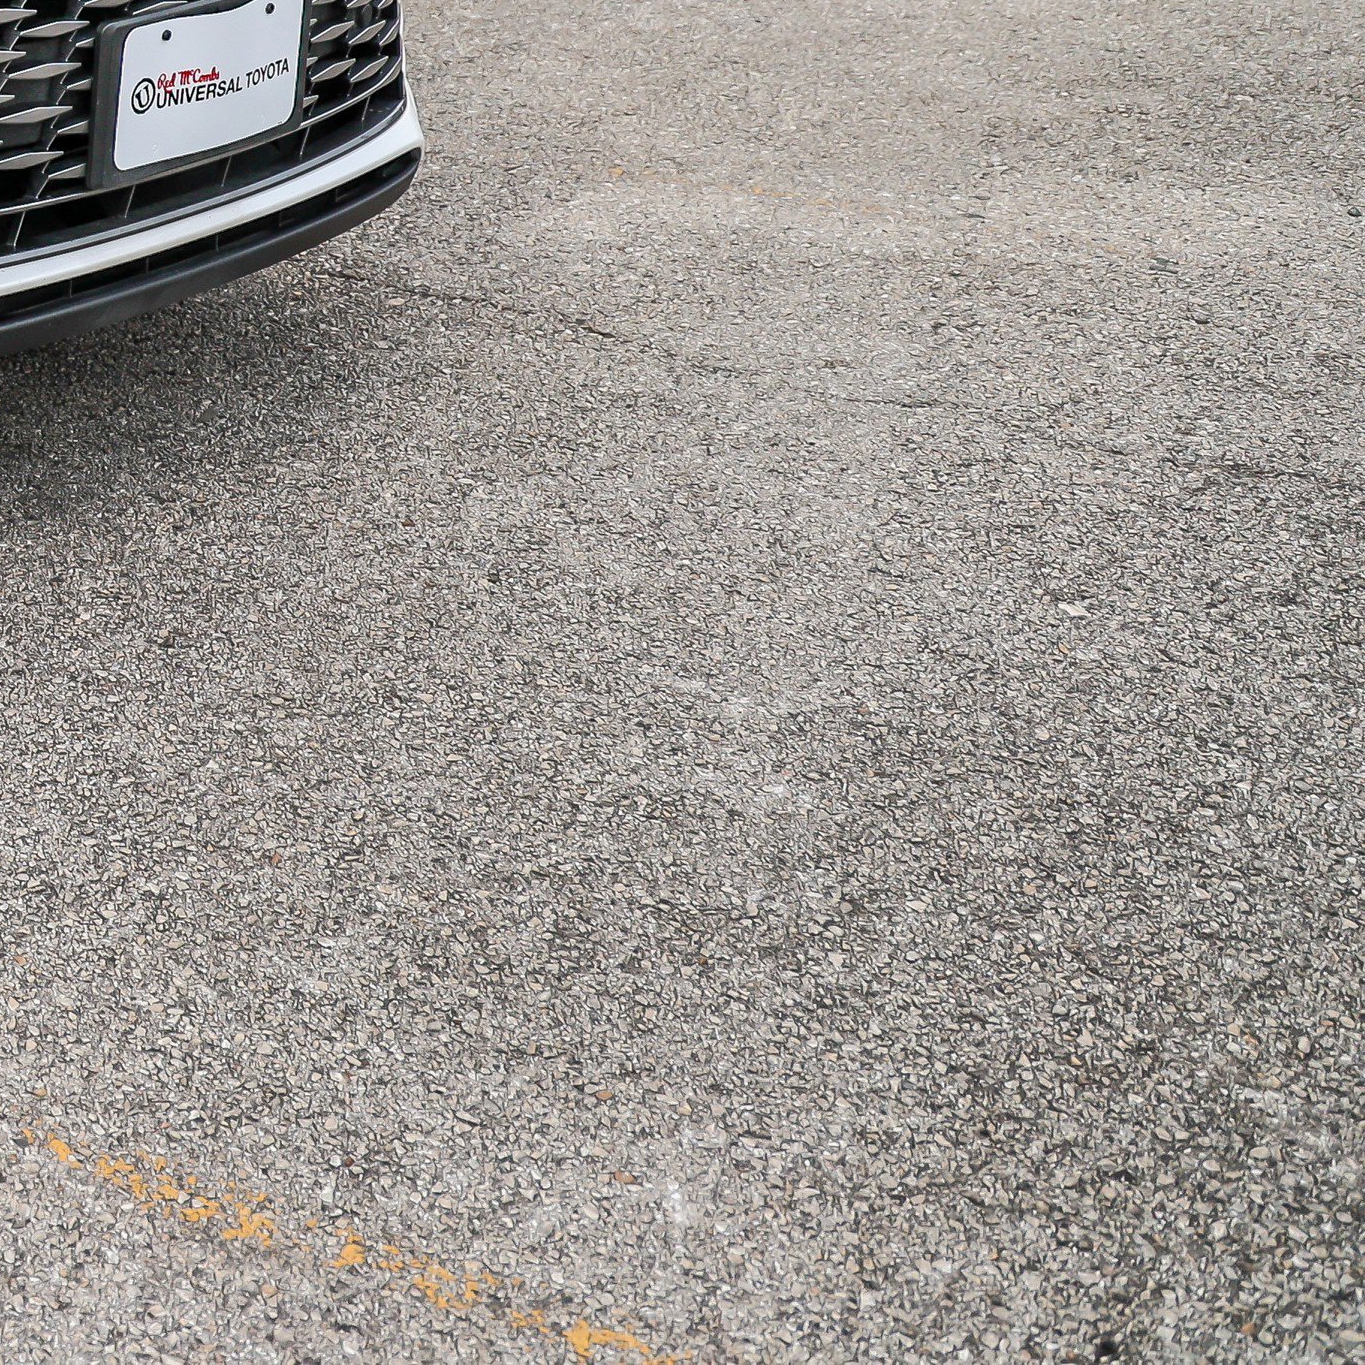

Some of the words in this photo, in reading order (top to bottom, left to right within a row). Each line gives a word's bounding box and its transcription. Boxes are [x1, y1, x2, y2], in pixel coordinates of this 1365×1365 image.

[156, 78, 243, 109] UNIVERSAL
[245, 58, 290, 88] TOYOTA
[157, 73, 176, 94] Red
